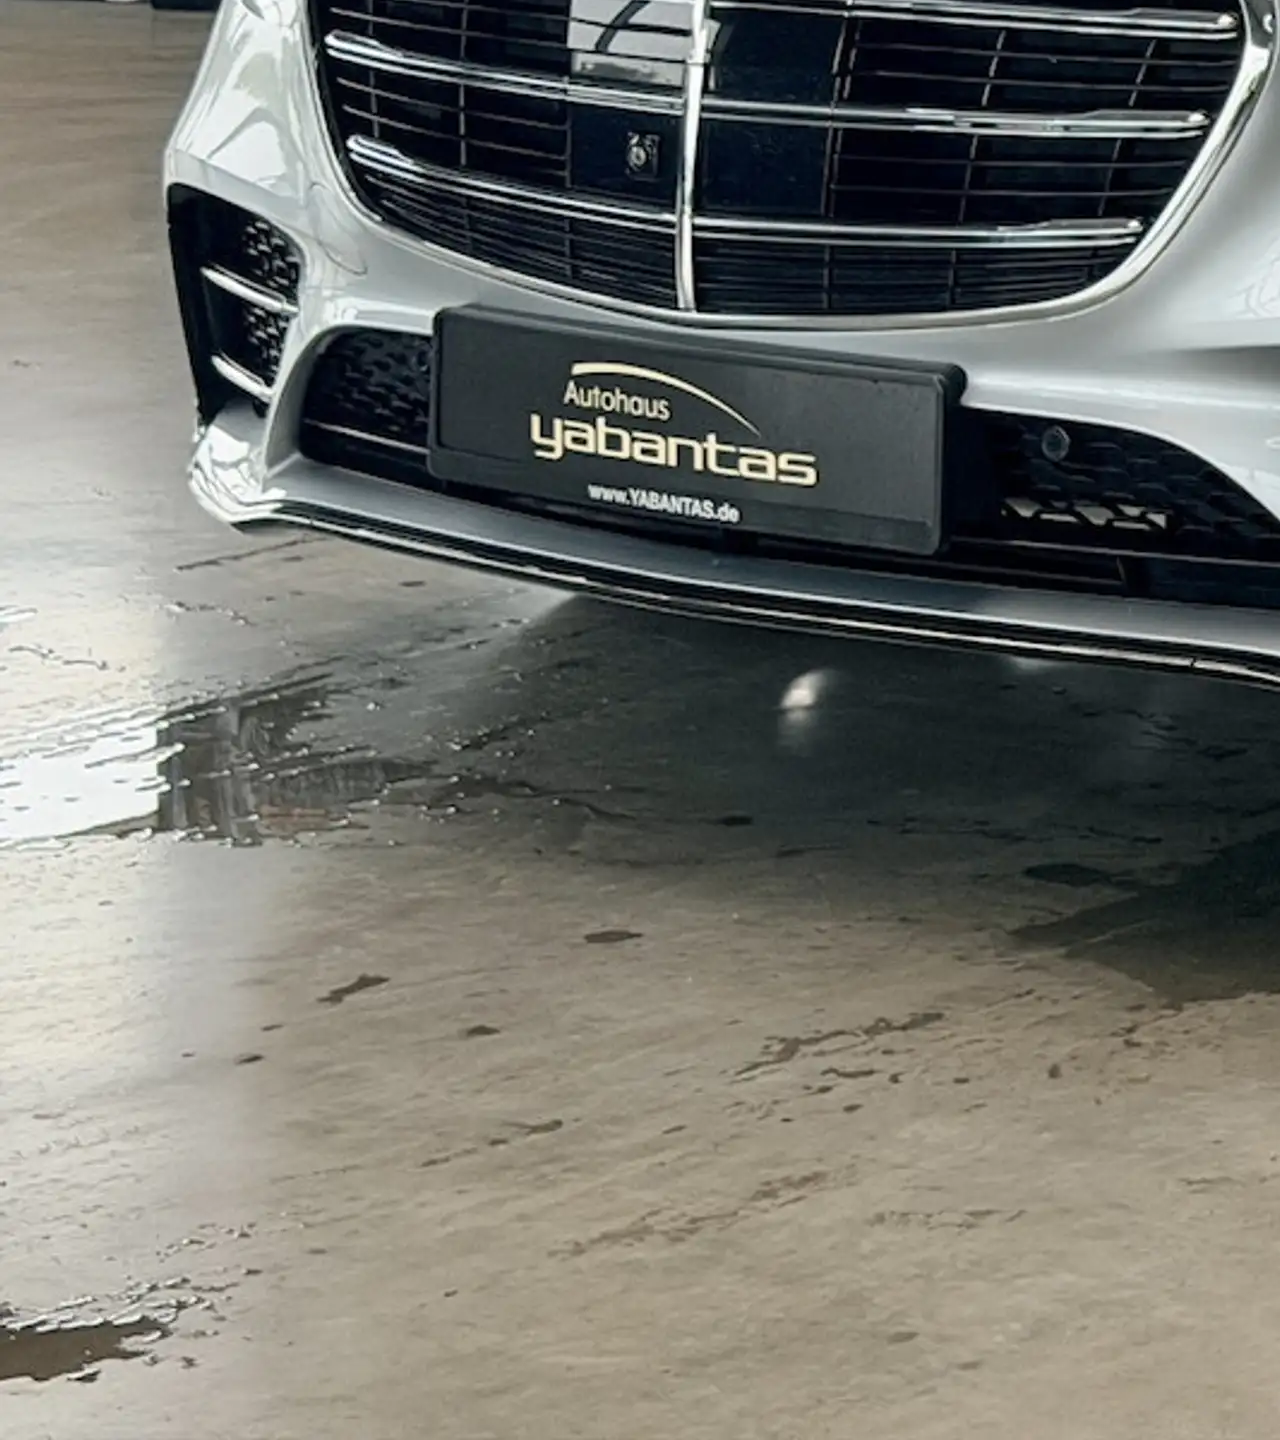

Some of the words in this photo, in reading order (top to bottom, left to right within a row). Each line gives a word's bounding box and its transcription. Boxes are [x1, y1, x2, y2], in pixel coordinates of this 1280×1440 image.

[563, 381, 671, 422] Autohaus
[531, 412, 818, 486] yabantas
[588, 483, 740, 523] www.YABANTAS.de
